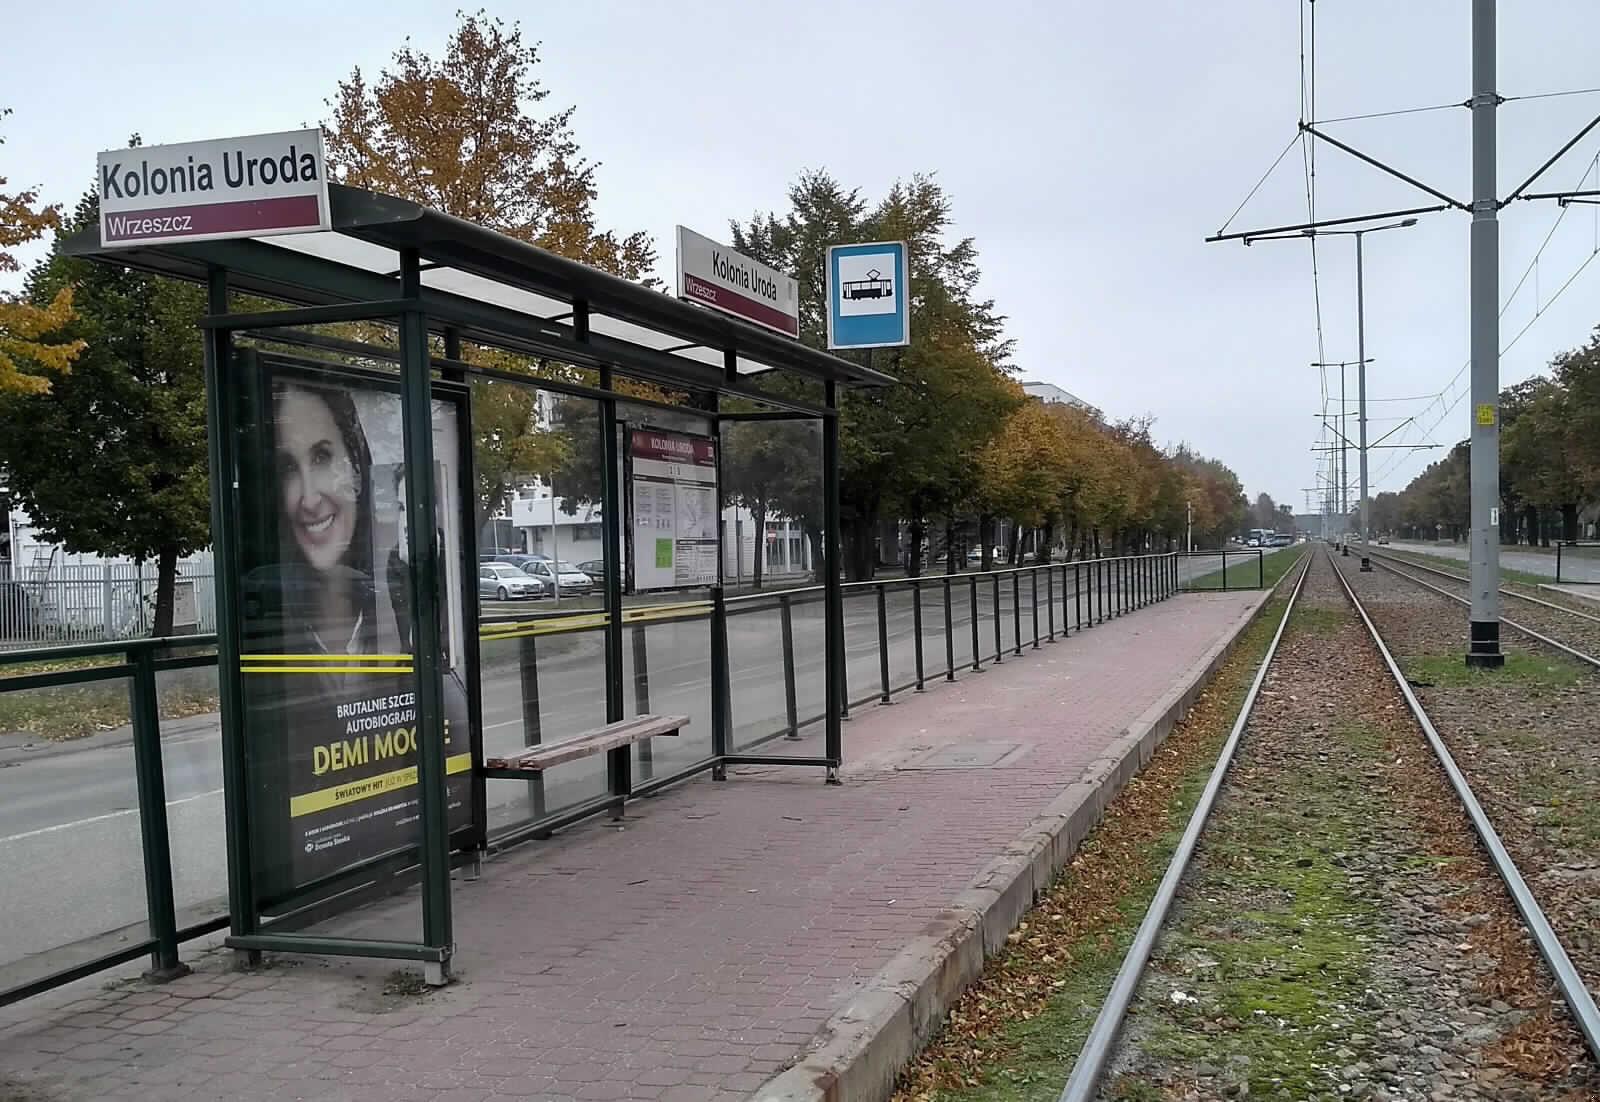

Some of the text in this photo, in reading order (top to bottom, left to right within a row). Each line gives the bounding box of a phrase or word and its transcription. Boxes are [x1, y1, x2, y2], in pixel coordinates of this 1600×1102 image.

[102, 145, 318, 199] Kolonia Uroda
[108, 215, 193, 236] Wrzeszcz
[712, 250, 777, 301] Kolonia Uroda
[685, 277, 717, 302] Wrzeszcz
[336, 697, 387, 719] BRUTALNIE
[313, 736, 369, 775] DEMI
[335, 784, 372, 800] ŚWIATOWY
[372, 780, 384, 790] HIT
